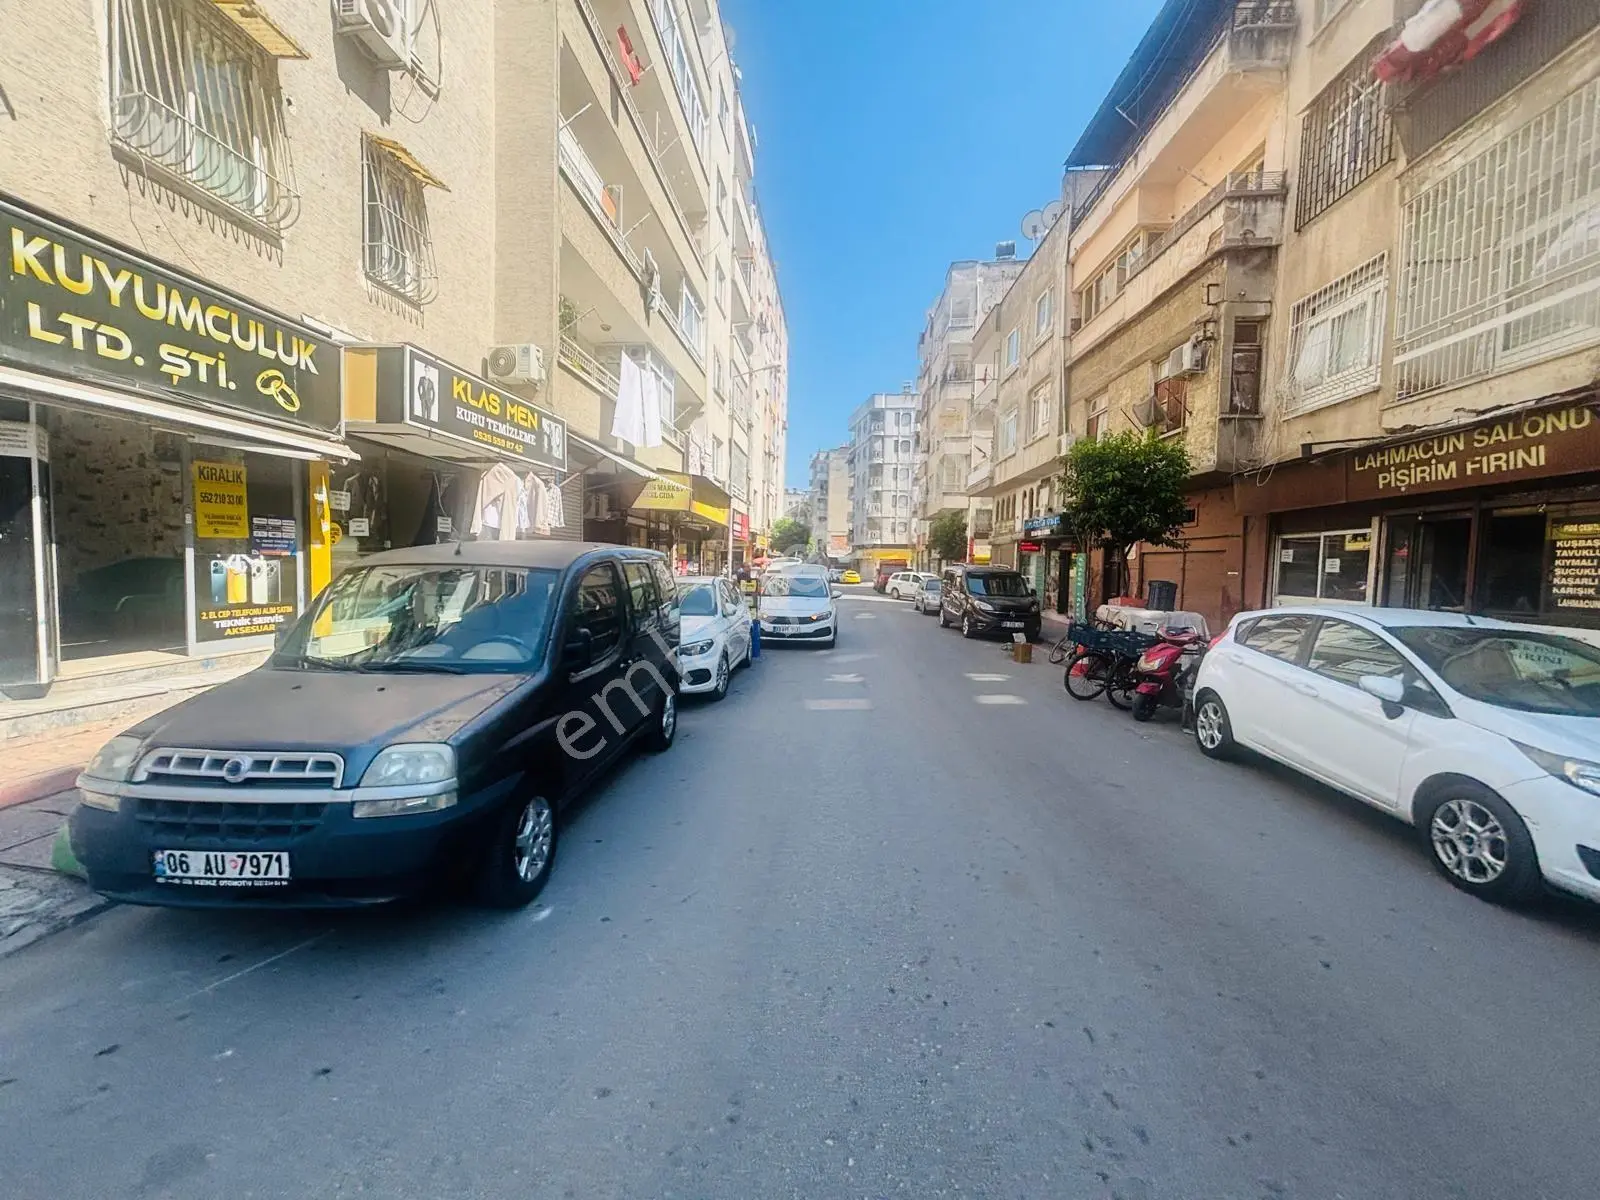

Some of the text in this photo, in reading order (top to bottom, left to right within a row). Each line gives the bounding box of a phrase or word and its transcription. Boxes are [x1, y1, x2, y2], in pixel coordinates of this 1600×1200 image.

[11, 227, 319, 375] KUYUMCULUK
[28, 302, 145, 366] LTD.
[452, 376, 538, 430] KLAS MEN
[456, 406, 537, 446] KURU TEMİZLEME
[1354, 408, 1592, 471] LAHMACUN SALONU
[198, 465, 243, 484] KİRALIK
[1378, 445, 1546, 491] PİŞİRİM FIRINI
[1555, 568, 1600, 576] SUCUKL
[213, 613, 285, 629] TEKNİK SERVİS
[224, 624, 276, 636] AKSESUAR
[167, 852, 283, 876] 06 AU 7971
